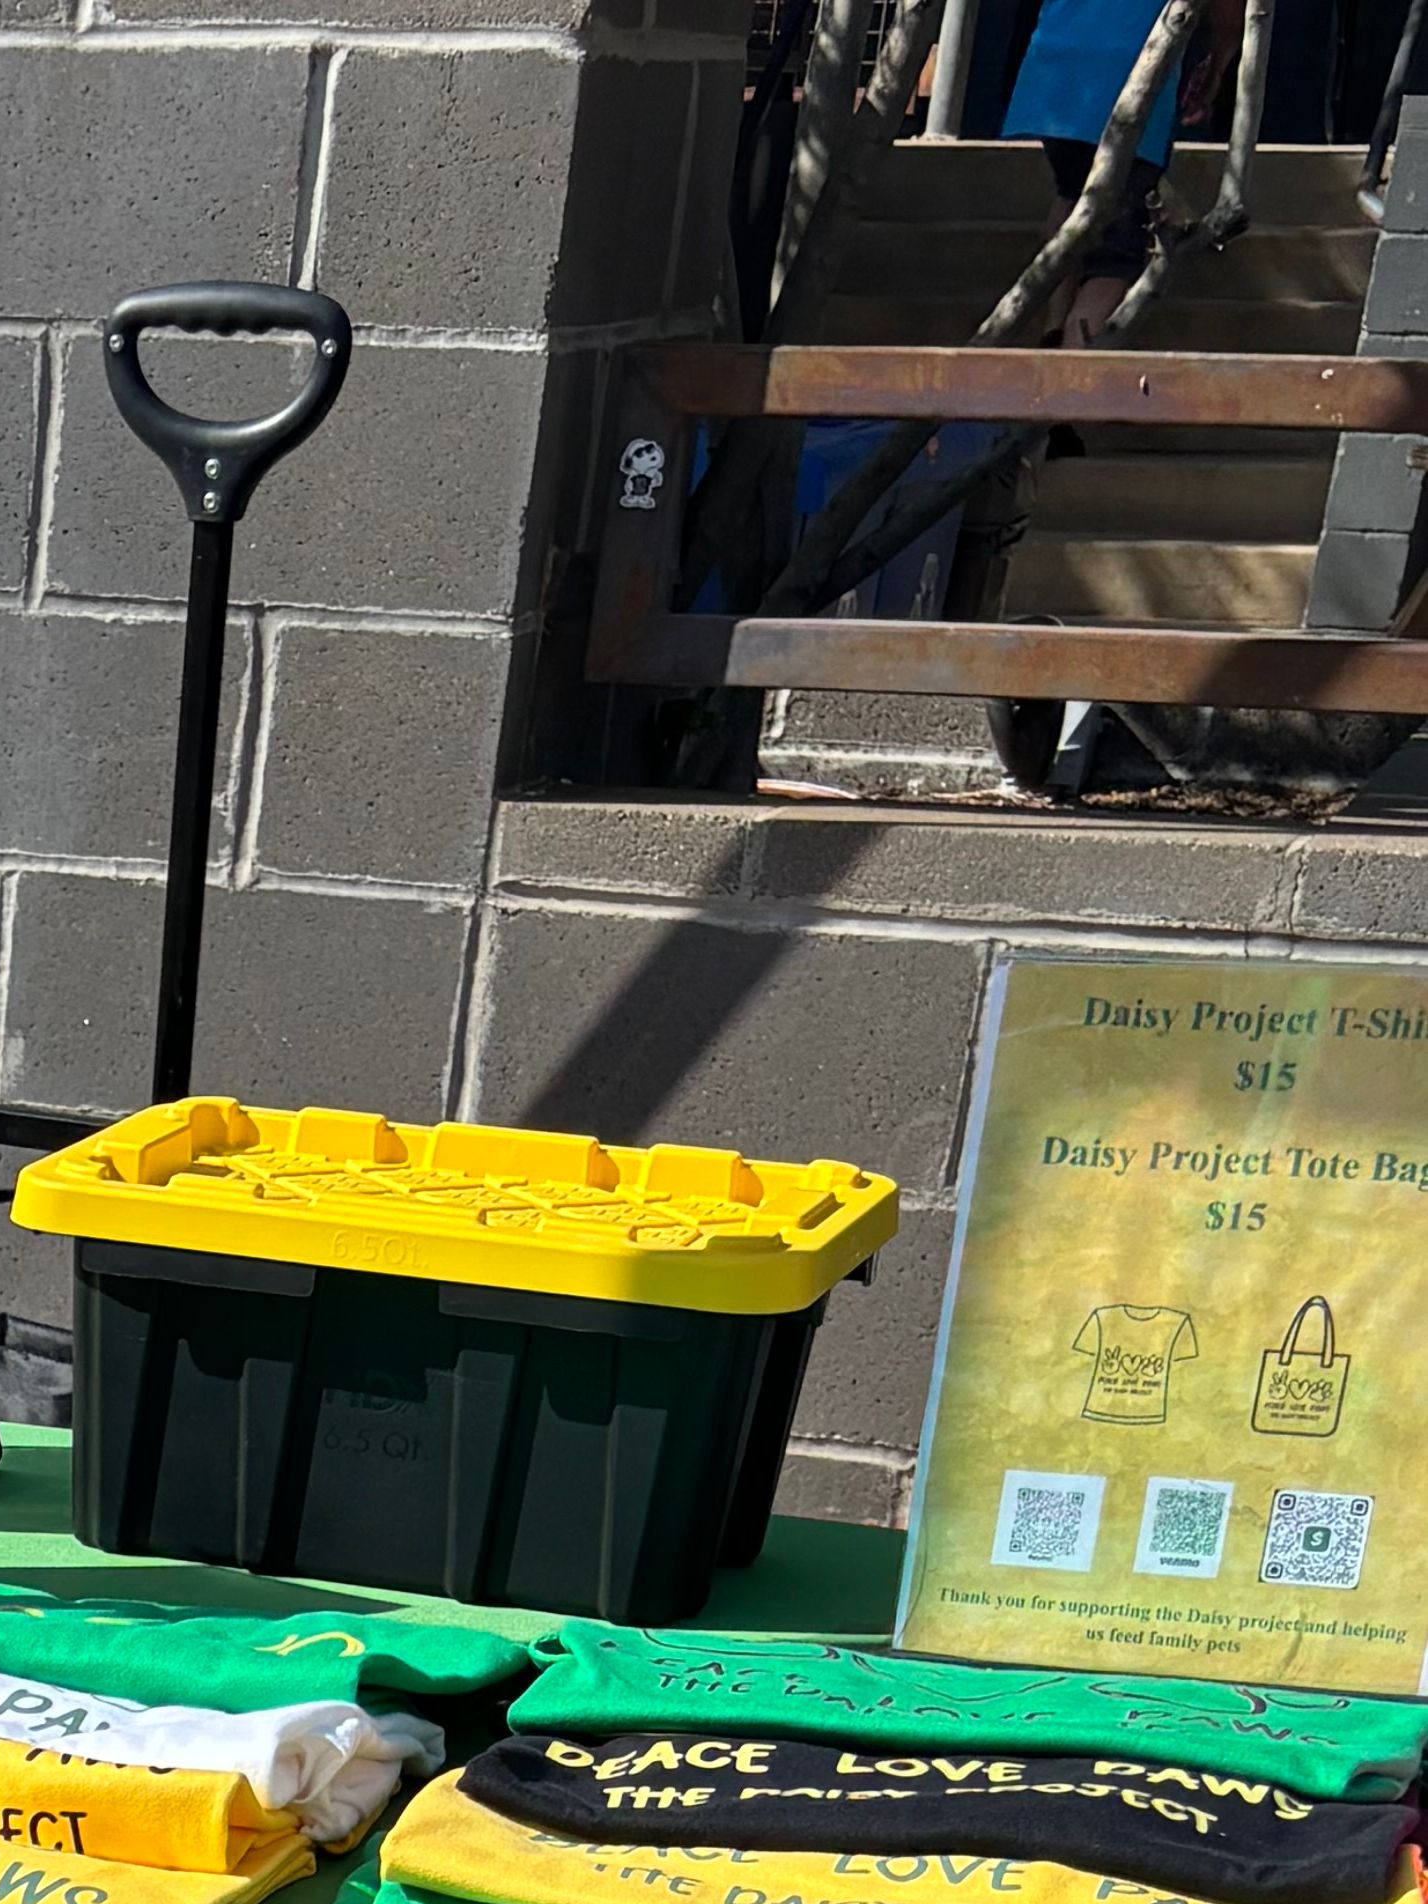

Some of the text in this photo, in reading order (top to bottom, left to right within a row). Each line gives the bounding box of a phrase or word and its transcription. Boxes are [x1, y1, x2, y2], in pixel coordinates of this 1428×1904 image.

[1082, 996, 1180, 1036] Daisy
[1190, 1000, 1318, 1037] Project
[1233, 1059, 1299, 1093] $15
[1043, 1135, 1137, 1175] Daisy
[1148, 1140, 1272, 1182] Project
[1286, 1146, 1360, 1181] Tote
[1204, 1200, 1268, 1233] $15
[939, 1587, 1408, 1645] Thank you for supporting the Daisy project and helping
[1085, 1627, 1242, 1656] us feed family pets
[545, 1740, 1314, 1821] PEACE LOVE PAWS
[602, 1785, 716, 1809] THE
[833, 1854, 1026, 1892] LOVE
